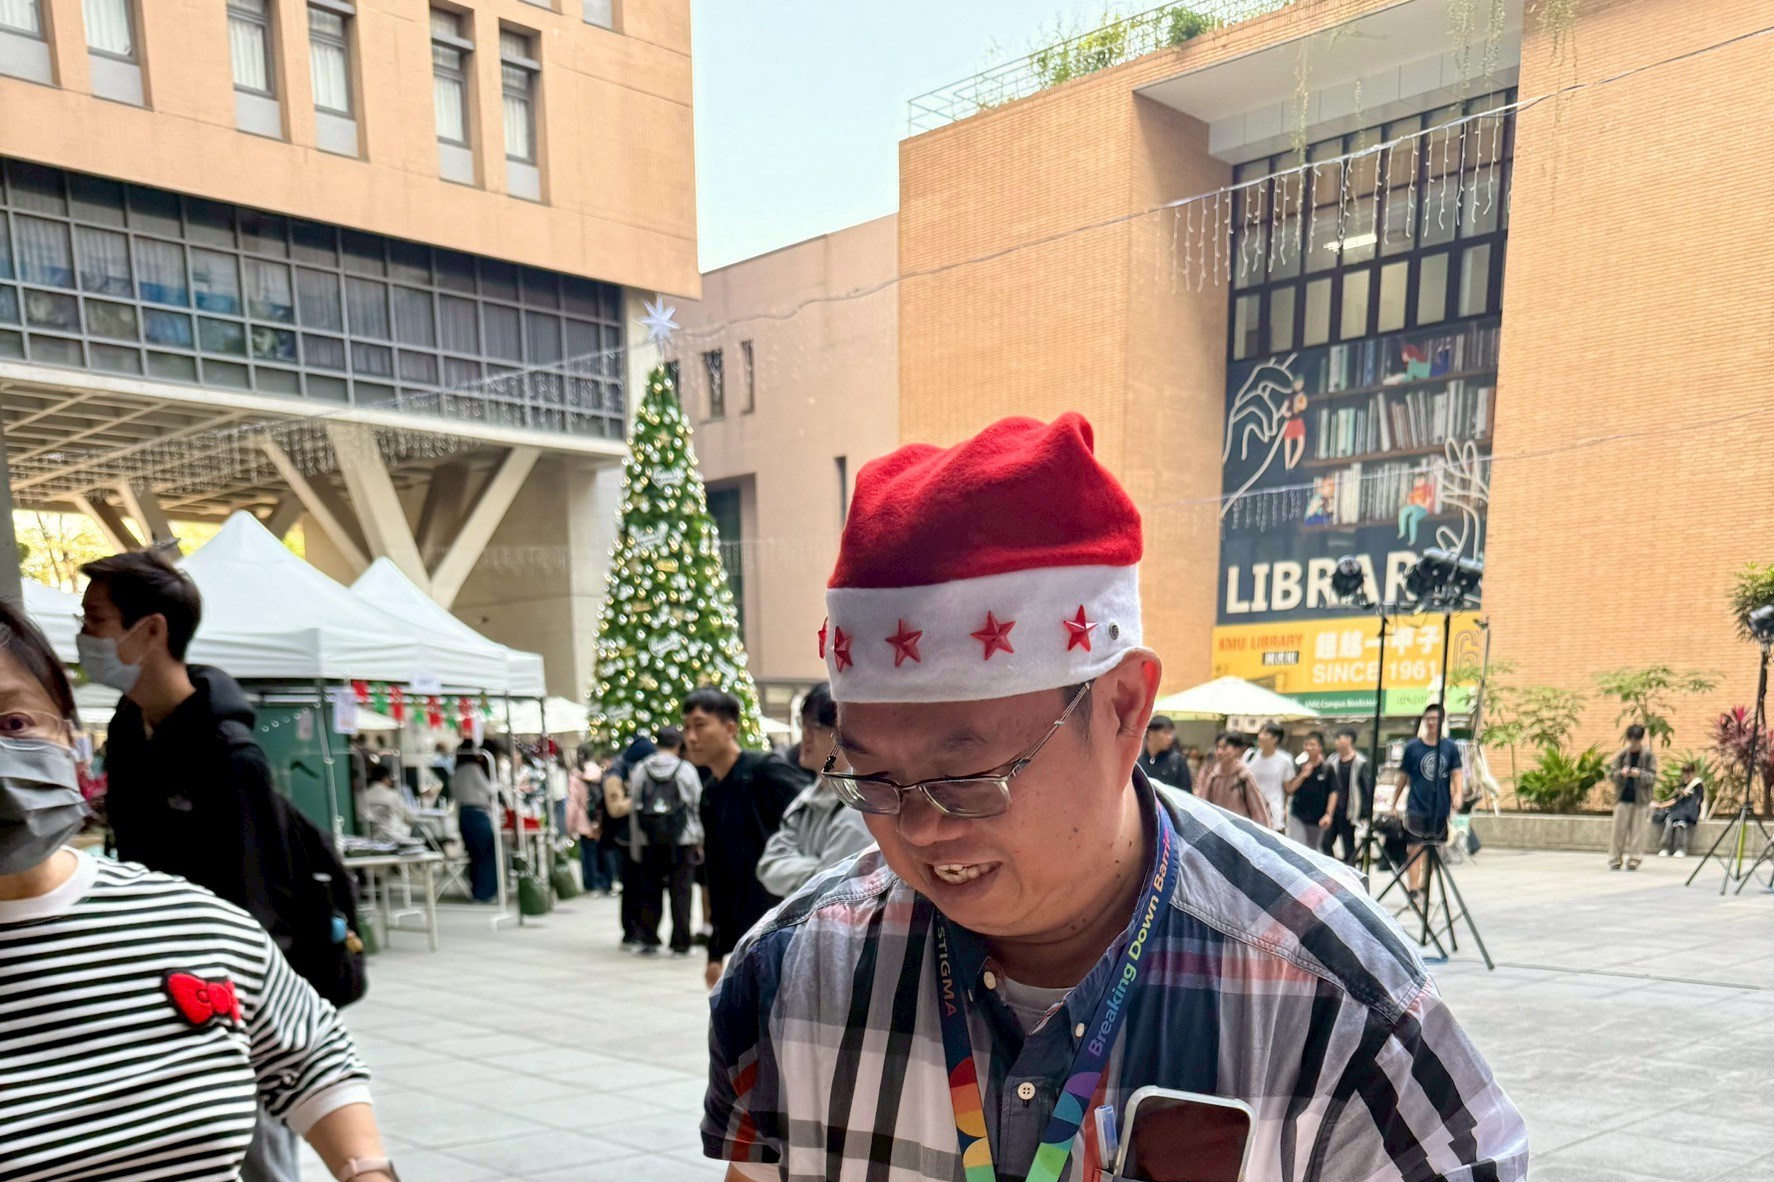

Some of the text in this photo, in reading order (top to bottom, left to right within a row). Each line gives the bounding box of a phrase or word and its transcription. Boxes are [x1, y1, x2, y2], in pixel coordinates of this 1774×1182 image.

[1226, 550, 1422, 614] LIBRAR
[1250, 633, 1304, 650] LIBRARY
[1312, 659, 1438, 685] SINCE 1961
[936, 925, 957, 1017] STIGMA
[1088, 965, 1138, 1057] Breaking
[1128, 894, 1160, 962] Down
